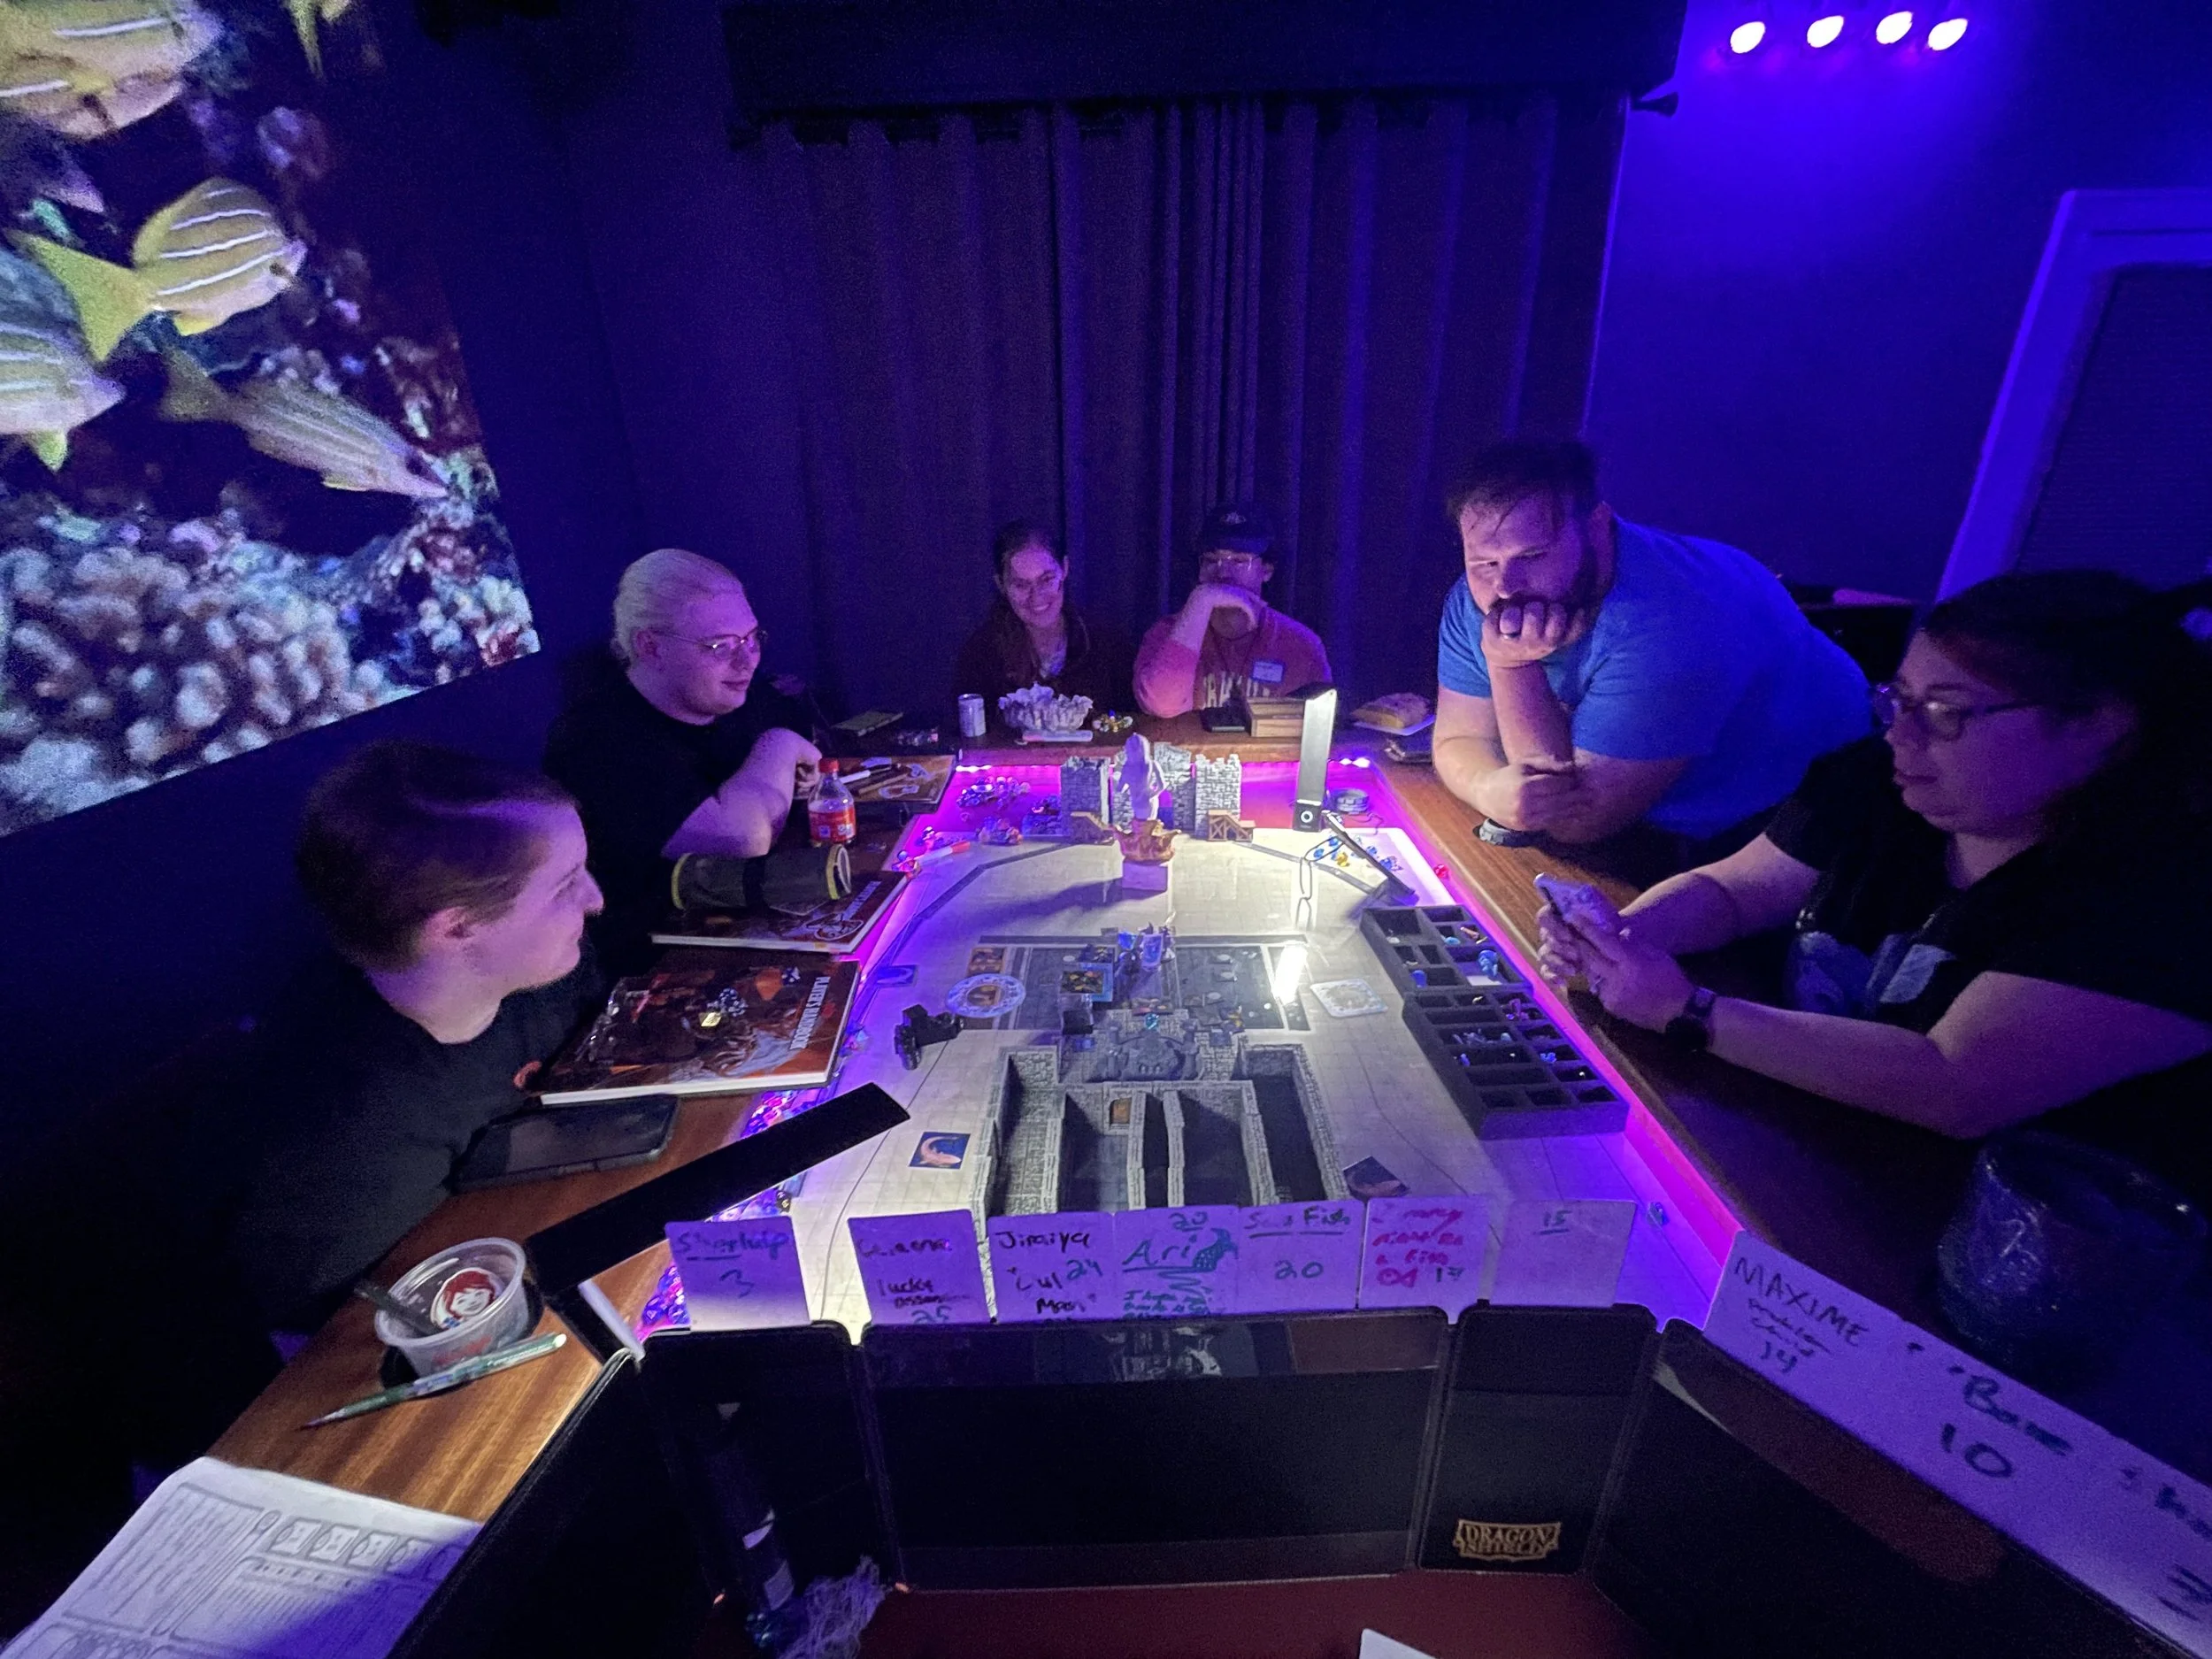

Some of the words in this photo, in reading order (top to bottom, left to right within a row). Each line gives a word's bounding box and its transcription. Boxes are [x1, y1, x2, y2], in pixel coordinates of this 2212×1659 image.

[1121, 1233, 1198, 1266] Ari
[719, 1269, 754, 1299] 3
[1275, 1259, 1324, 1279] 20
[1734, 1256, 1870, 1347] MAXIME
[1940, 1422, 2014, 1479] 10
[1465, 1525, 1554, 1545] DRAGON
